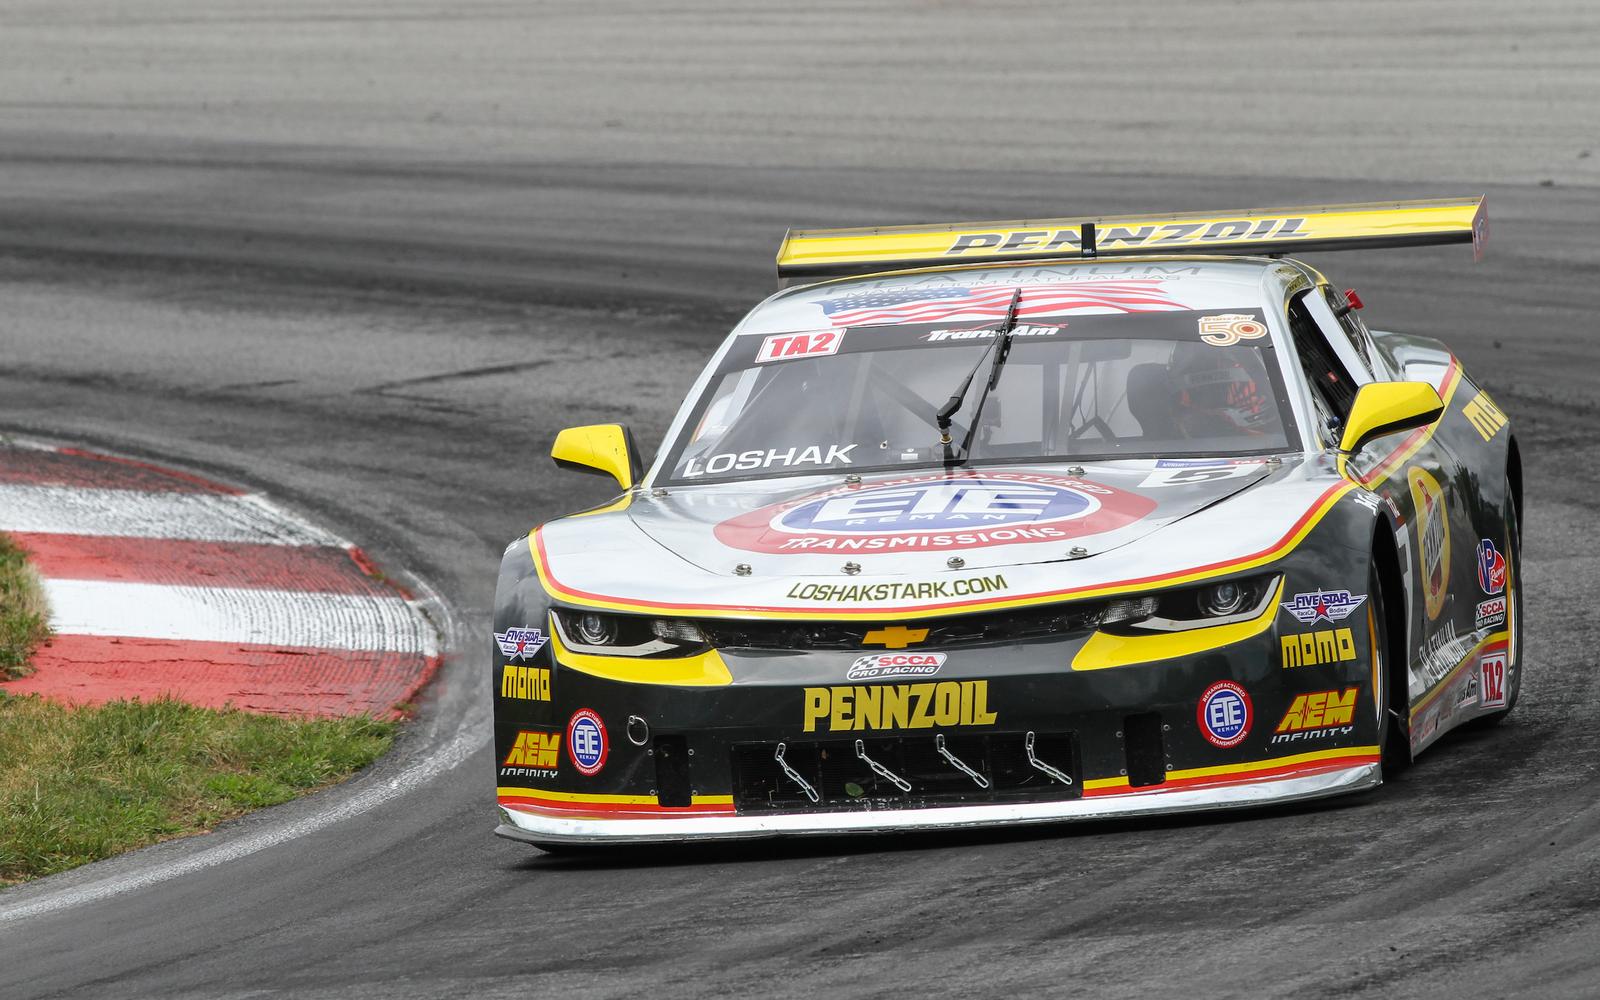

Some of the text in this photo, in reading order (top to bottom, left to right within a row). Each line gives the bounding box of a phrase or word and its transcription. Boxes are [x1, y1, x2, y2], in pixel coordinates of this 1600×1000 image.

[946, 218, 1312, 255] PENNZOIL
[825, 265, 1202, 295] PLATINUM
[1008, 325, 1060, 336] Am
[1199, 320, 1267, 346] 50
[770, 333, 835, 357] TA2
[682, 444, 858, 477] LOSHAK
[815, 484, 1058, 522] ETE
[846, 513, 1007, 526] REMAN
[778, 526, 1067, 550] TRANSMISSIONS
[785, 575, 1009, 602] LOSHAKSTARK.COM
[1295, 592, 1350, 609] FIVE STAR
[1481, 600, 1504, 616] SCCA
[505, 631, 540, 643] FIVE STAR
[851, 666, 936, 679] PRO RACING
[878, 655, 939, 667] SCCA
[1202, 683, 1246, 703] REMANUFACTURED
[1482, 660, 1503, 703] TA2
[803, 680, 998, 733] PENNZOIL
[1210, 696, 1242, 728] ETE
[1277, 687, 1359, 732] AEM
[574, 725, 599, 755] ETE
[1210, 730, 1248, 746] TRANSMISSIONS
[1271, 726, 1354, 743] INFINITY
[505, 731, 561, 767] AEM
[500, 768, 559, 778] INFINITY
